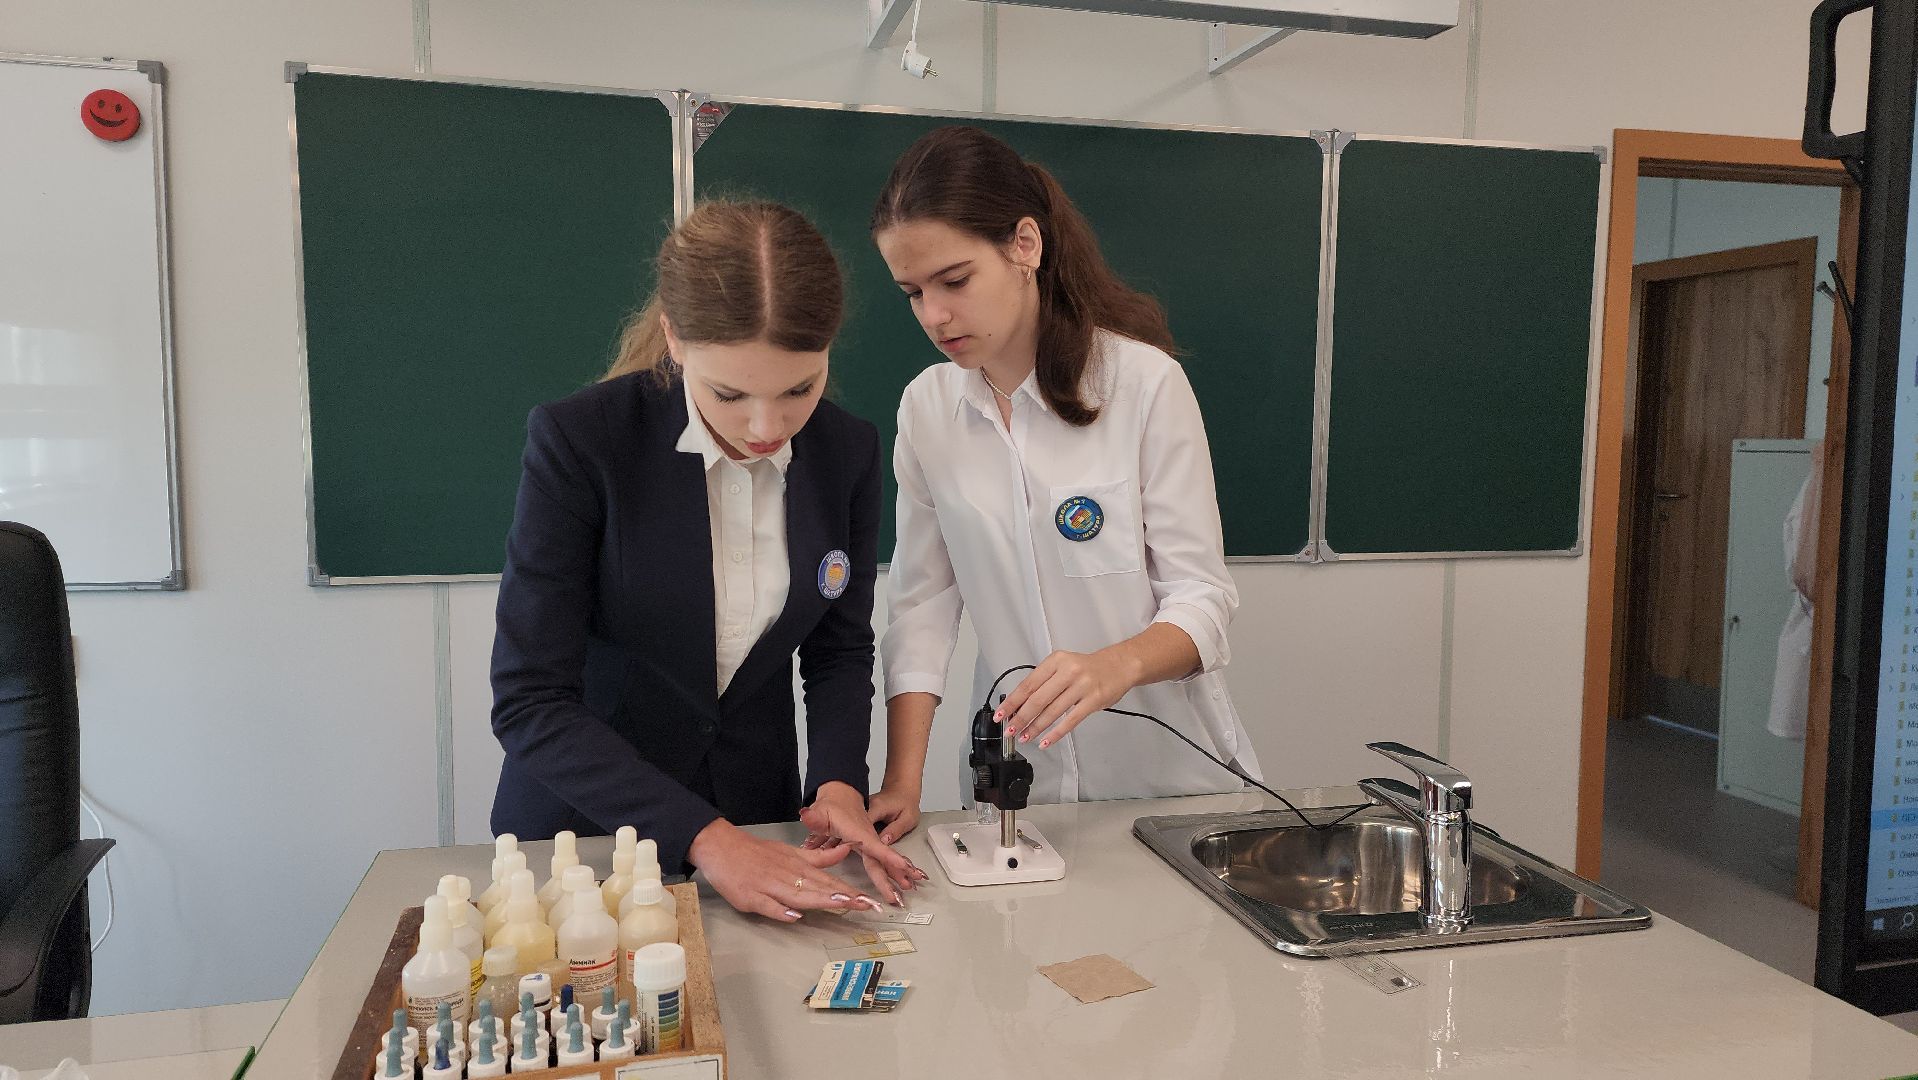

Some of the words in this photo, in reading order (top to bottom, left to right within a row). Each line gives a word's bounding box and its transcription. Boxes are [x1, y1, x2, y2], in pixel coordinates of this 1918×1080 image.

[1058, 502, 1073, 525] ШКОЛА
[1082, 515, 1101, 539] ШАТУРА
[826, 551, 844, 564] ШКОЛА
